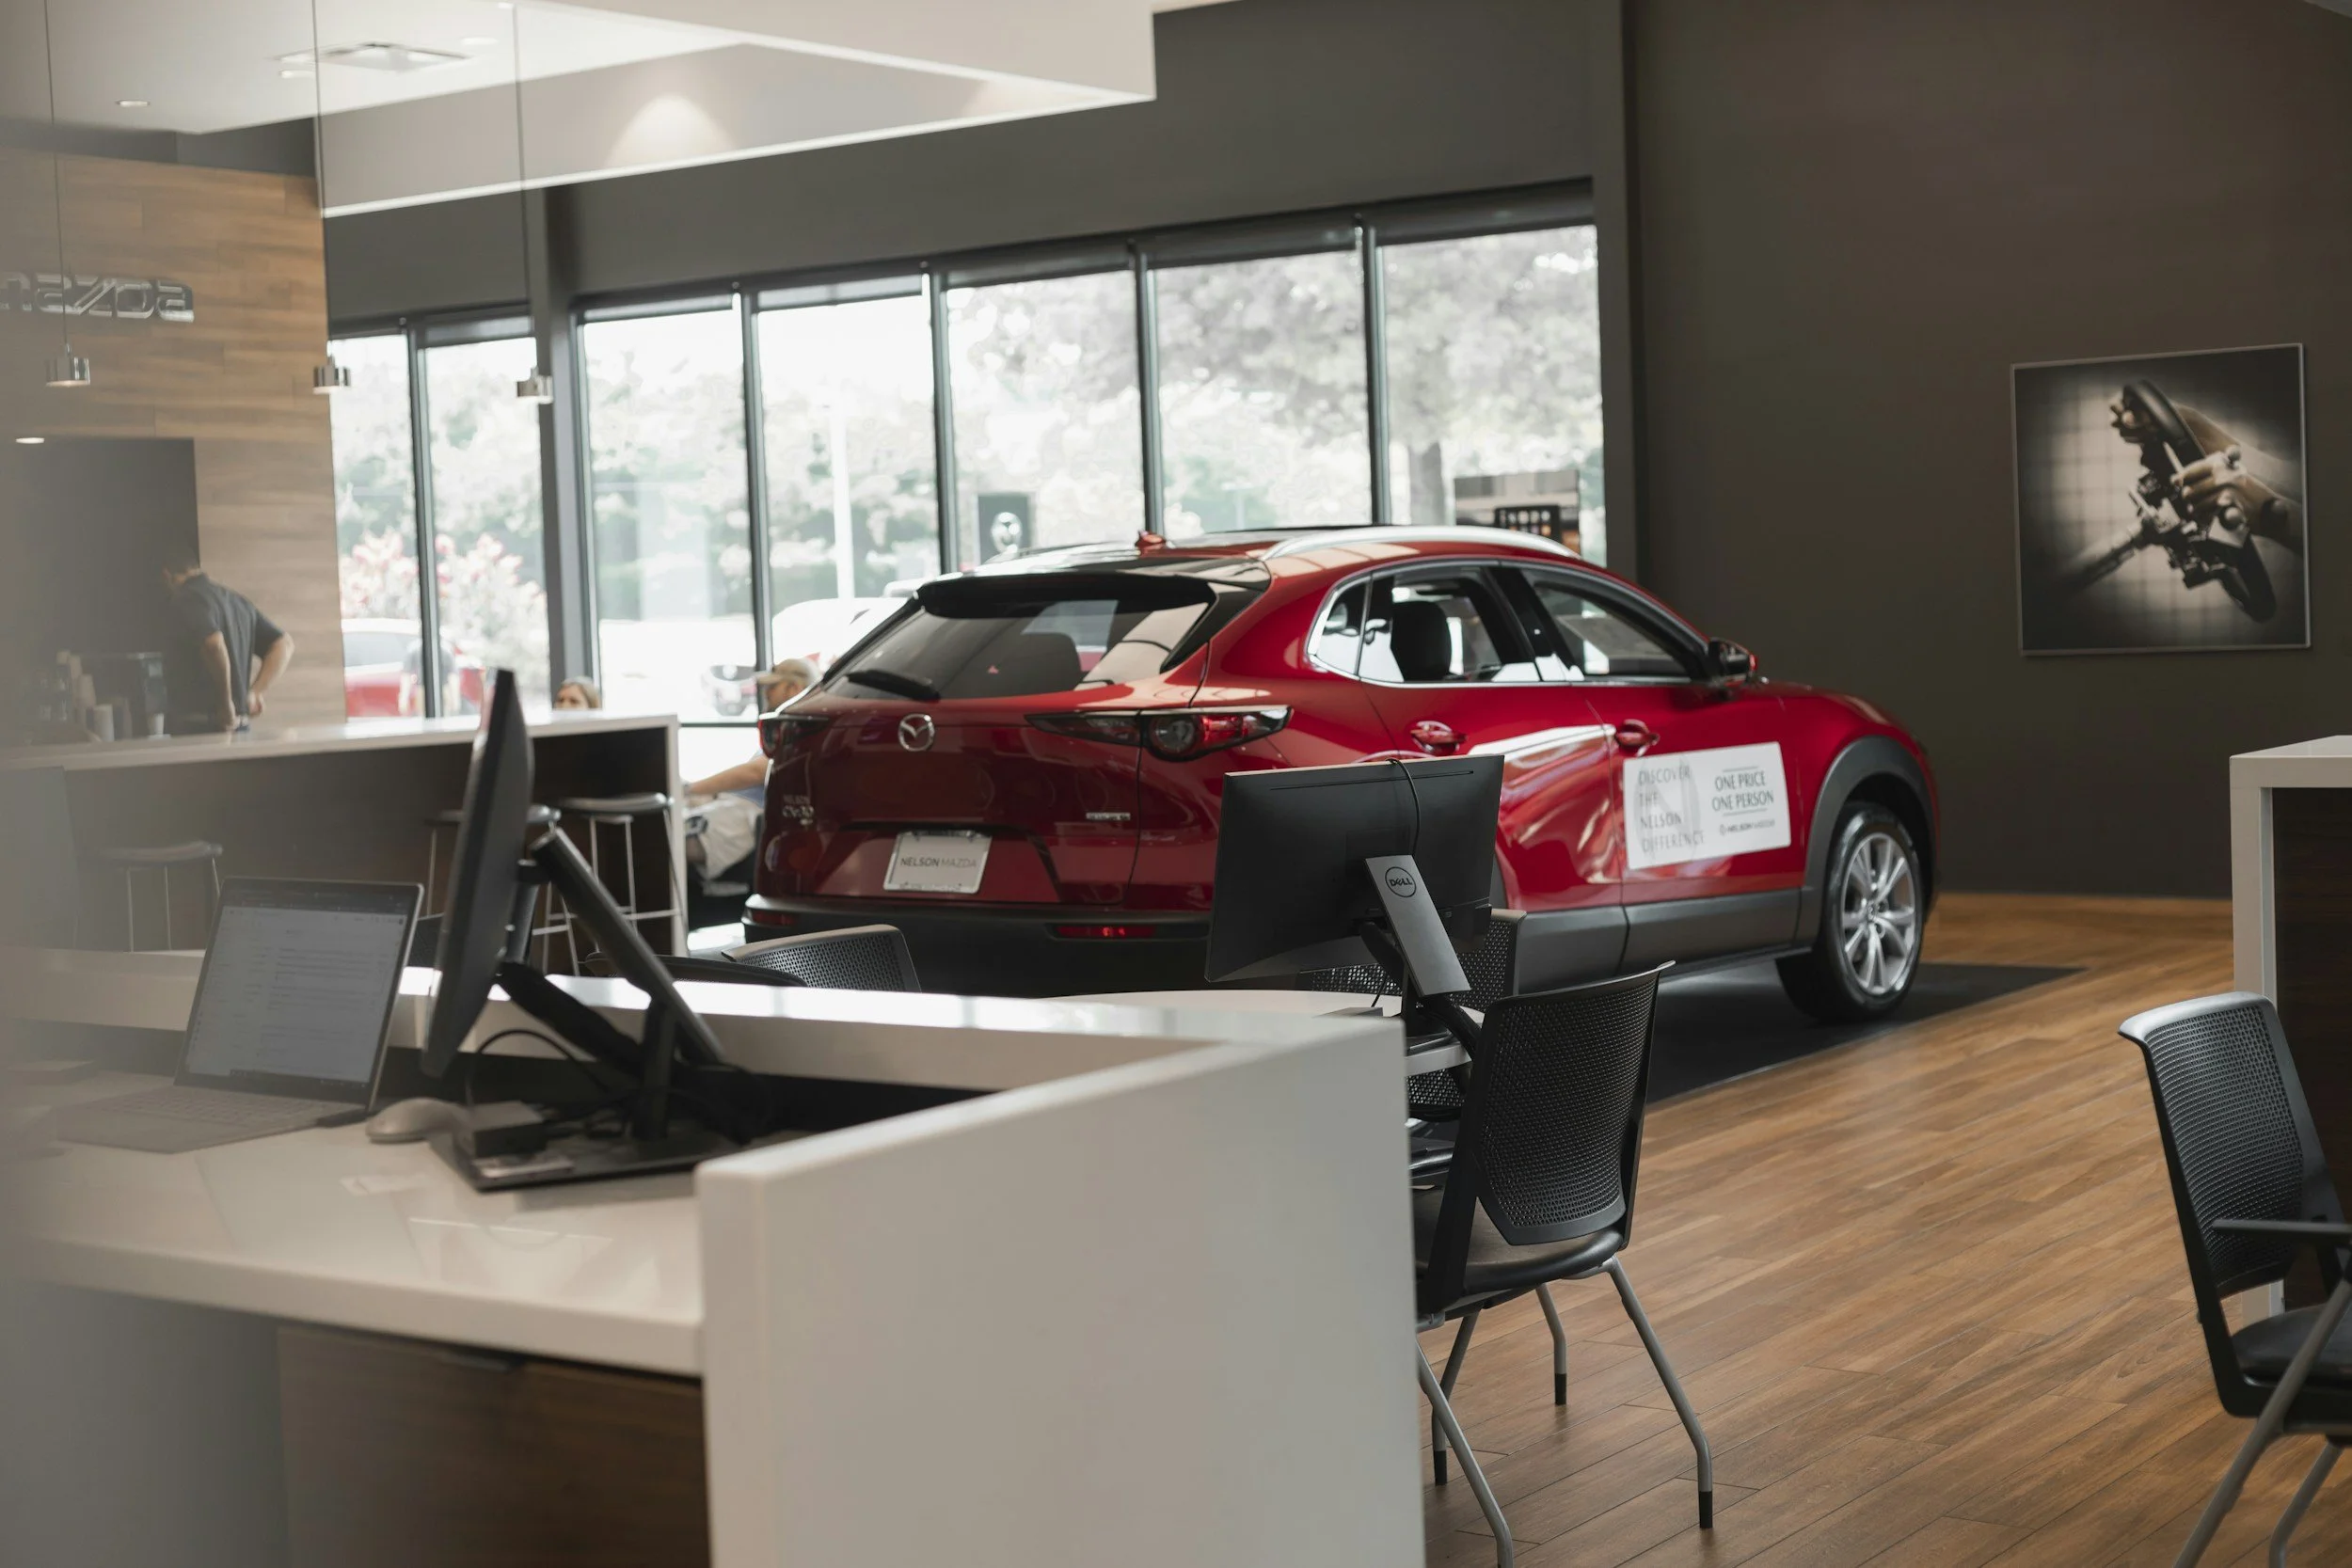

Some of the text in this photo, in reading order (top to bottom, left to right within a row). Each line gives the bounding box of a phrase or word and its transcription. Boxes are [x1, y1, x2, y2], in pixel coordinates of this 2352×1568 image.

[1638, 765, 1692, 786] DISCOVER
[1714, 769, 1767, 792] ONE PRICE
[1639, 791, 1660, 807] THE
[1711, 789, 1774, 812] ONE PERSON
[1640, 812, 1682, 829] NELSON
[899, 856, 940, 867] NELSON
[1389, 878, 1413, 887] DELL
